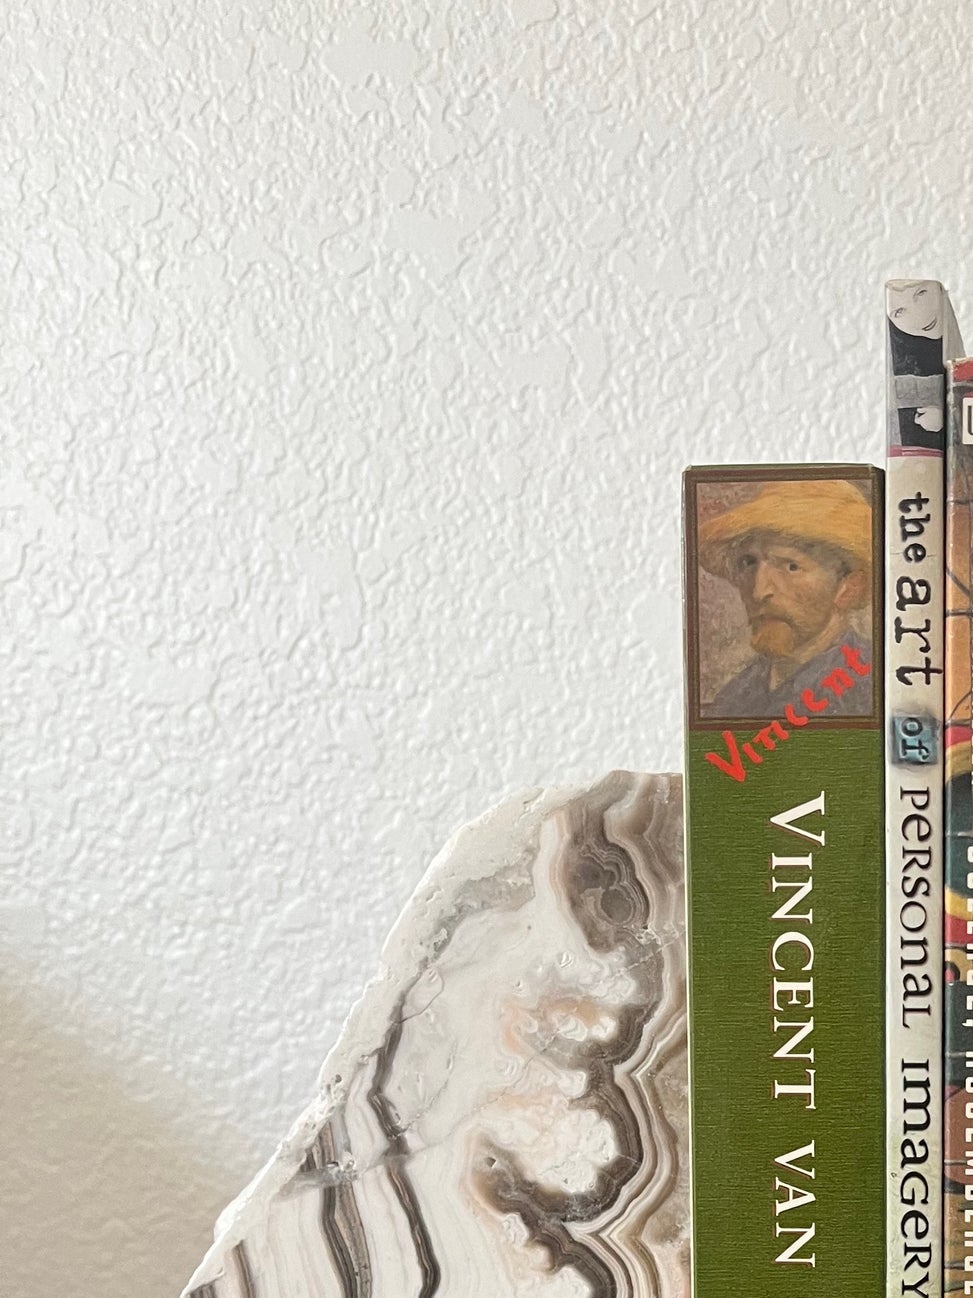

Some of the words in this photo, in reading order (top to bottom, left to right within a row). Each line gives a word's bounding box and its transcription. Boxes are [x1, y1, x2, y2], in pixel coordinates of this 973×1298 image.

[898, 491, 931, 563] the
[894, 576, 944, 686] art
[705, 645, 871, 782] Vincent
[900, 716, 930, 761] of
[769, 790, 826, 1109] VINCENT
[773, 1140, 817, 1267] VAN
